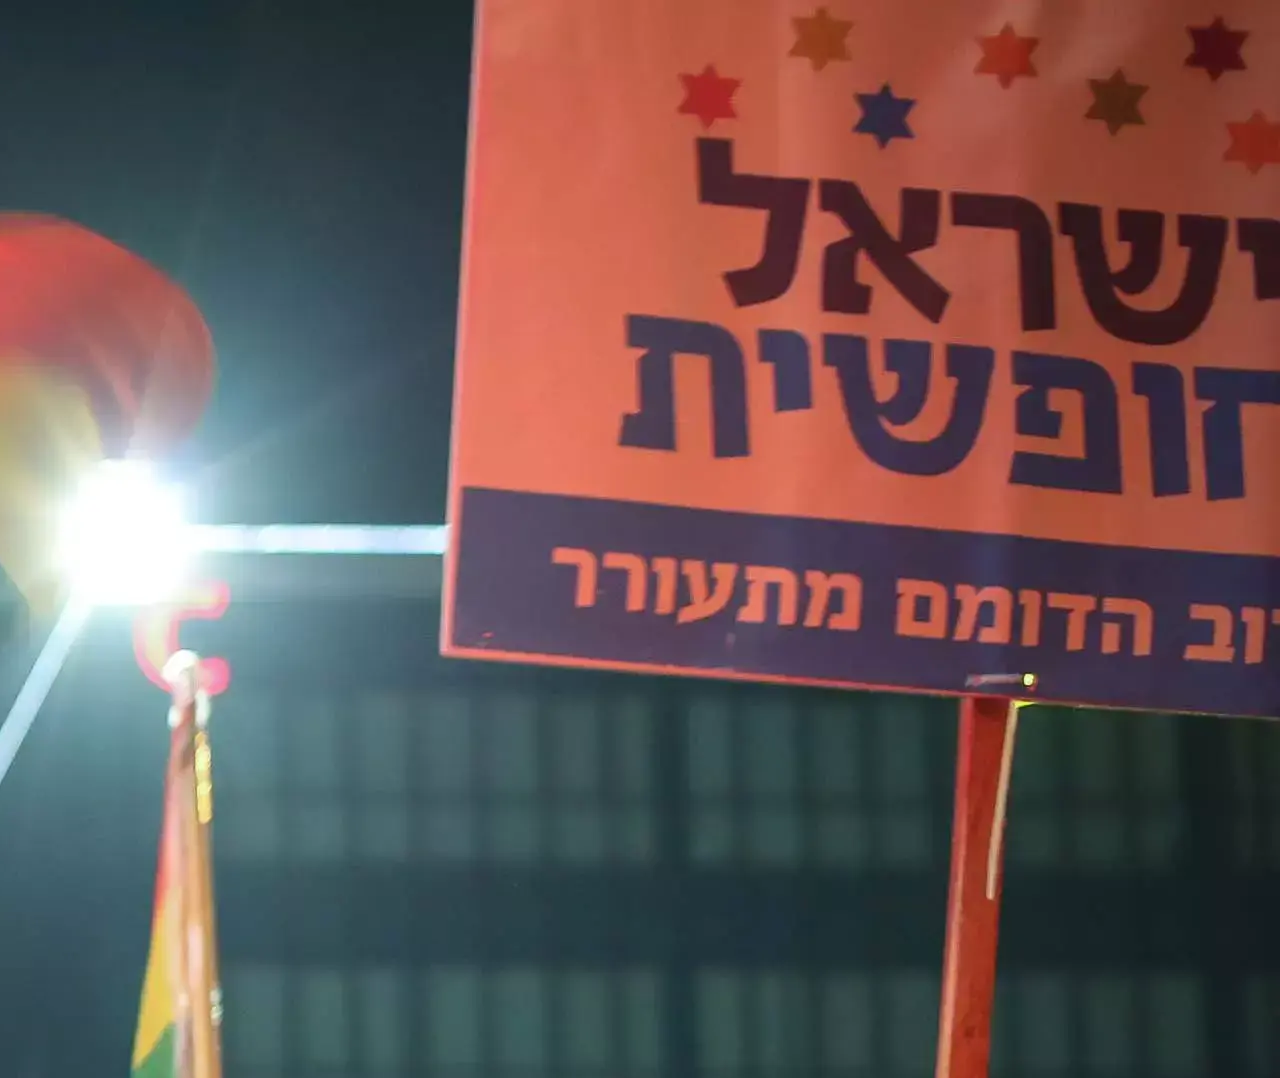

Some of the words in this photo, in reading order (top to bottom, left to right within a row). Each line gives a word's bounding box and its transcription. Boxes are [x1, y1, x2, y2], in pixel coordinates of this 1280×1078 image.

[695, 136, 1280, 347] ישראל
[551, 545, 863, 633] מתעורר
[894, 576, 1153, 659] הדומם
[1183, 602, 1280, 665] וב
